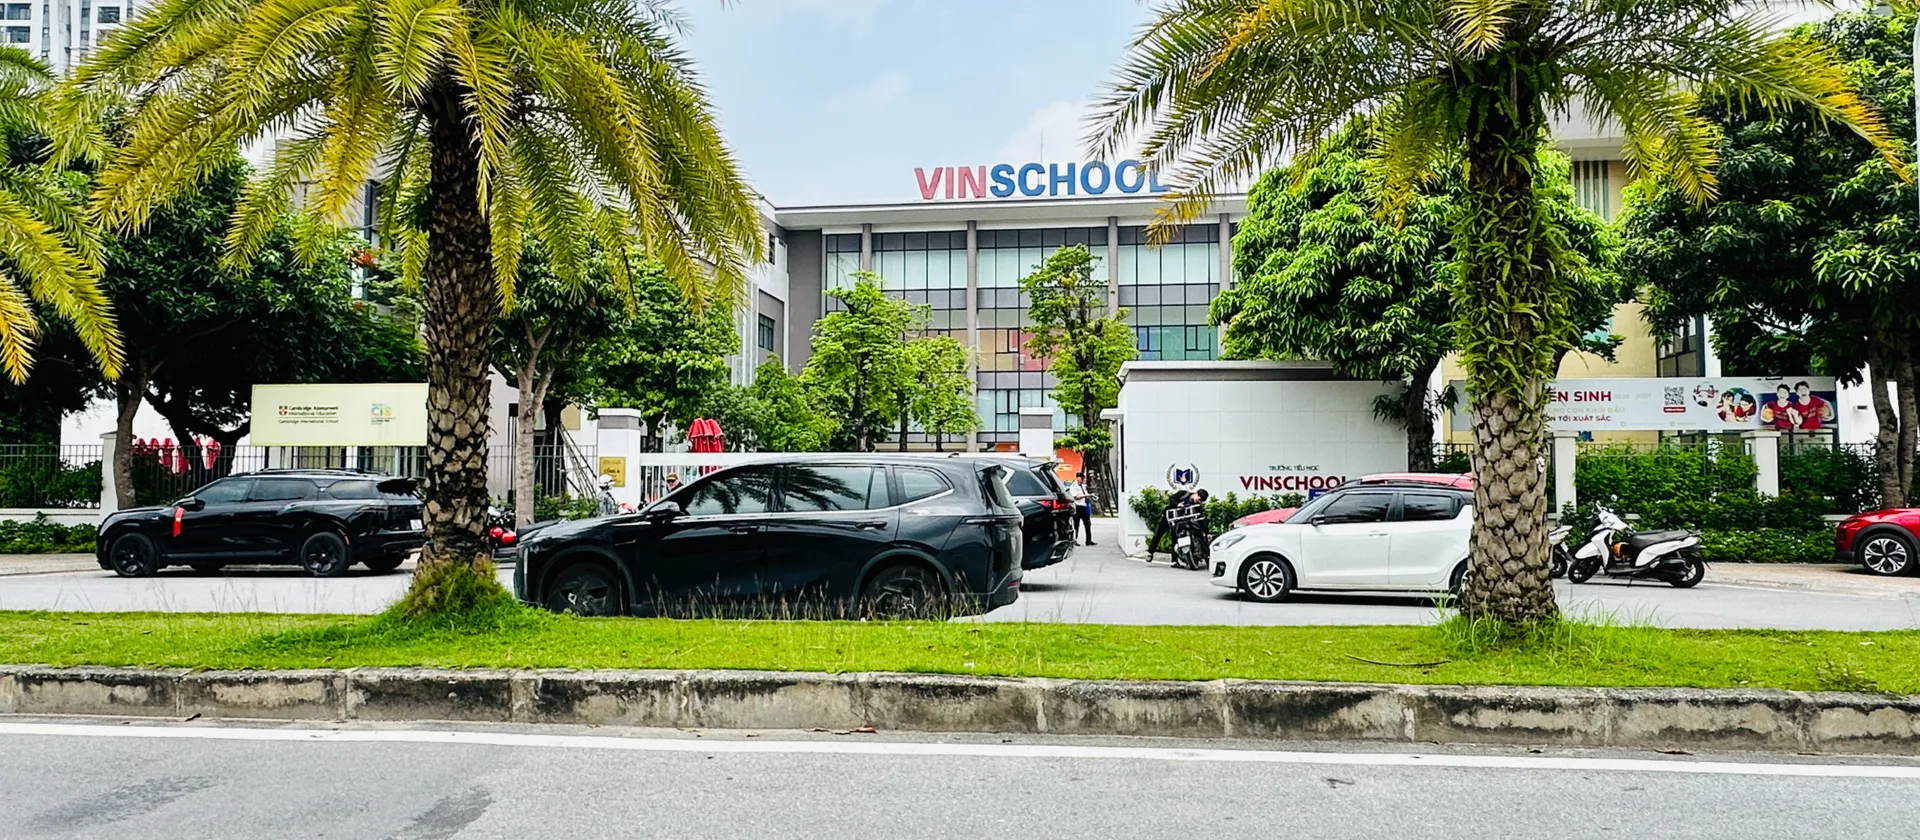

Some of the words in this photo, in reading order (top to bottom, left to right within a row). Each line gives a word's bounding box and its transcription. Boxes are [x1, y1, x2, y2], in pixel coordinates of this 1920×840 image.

[914, 159, 1169, 200] VINSCHOOL
[1574, 391, 1612, 402] SINH
[1558, 414, 1571, 422] TỚI
[1573, 413, 1594, 422] XUẤT
[1595, 413, 1612, 422] SẮC
